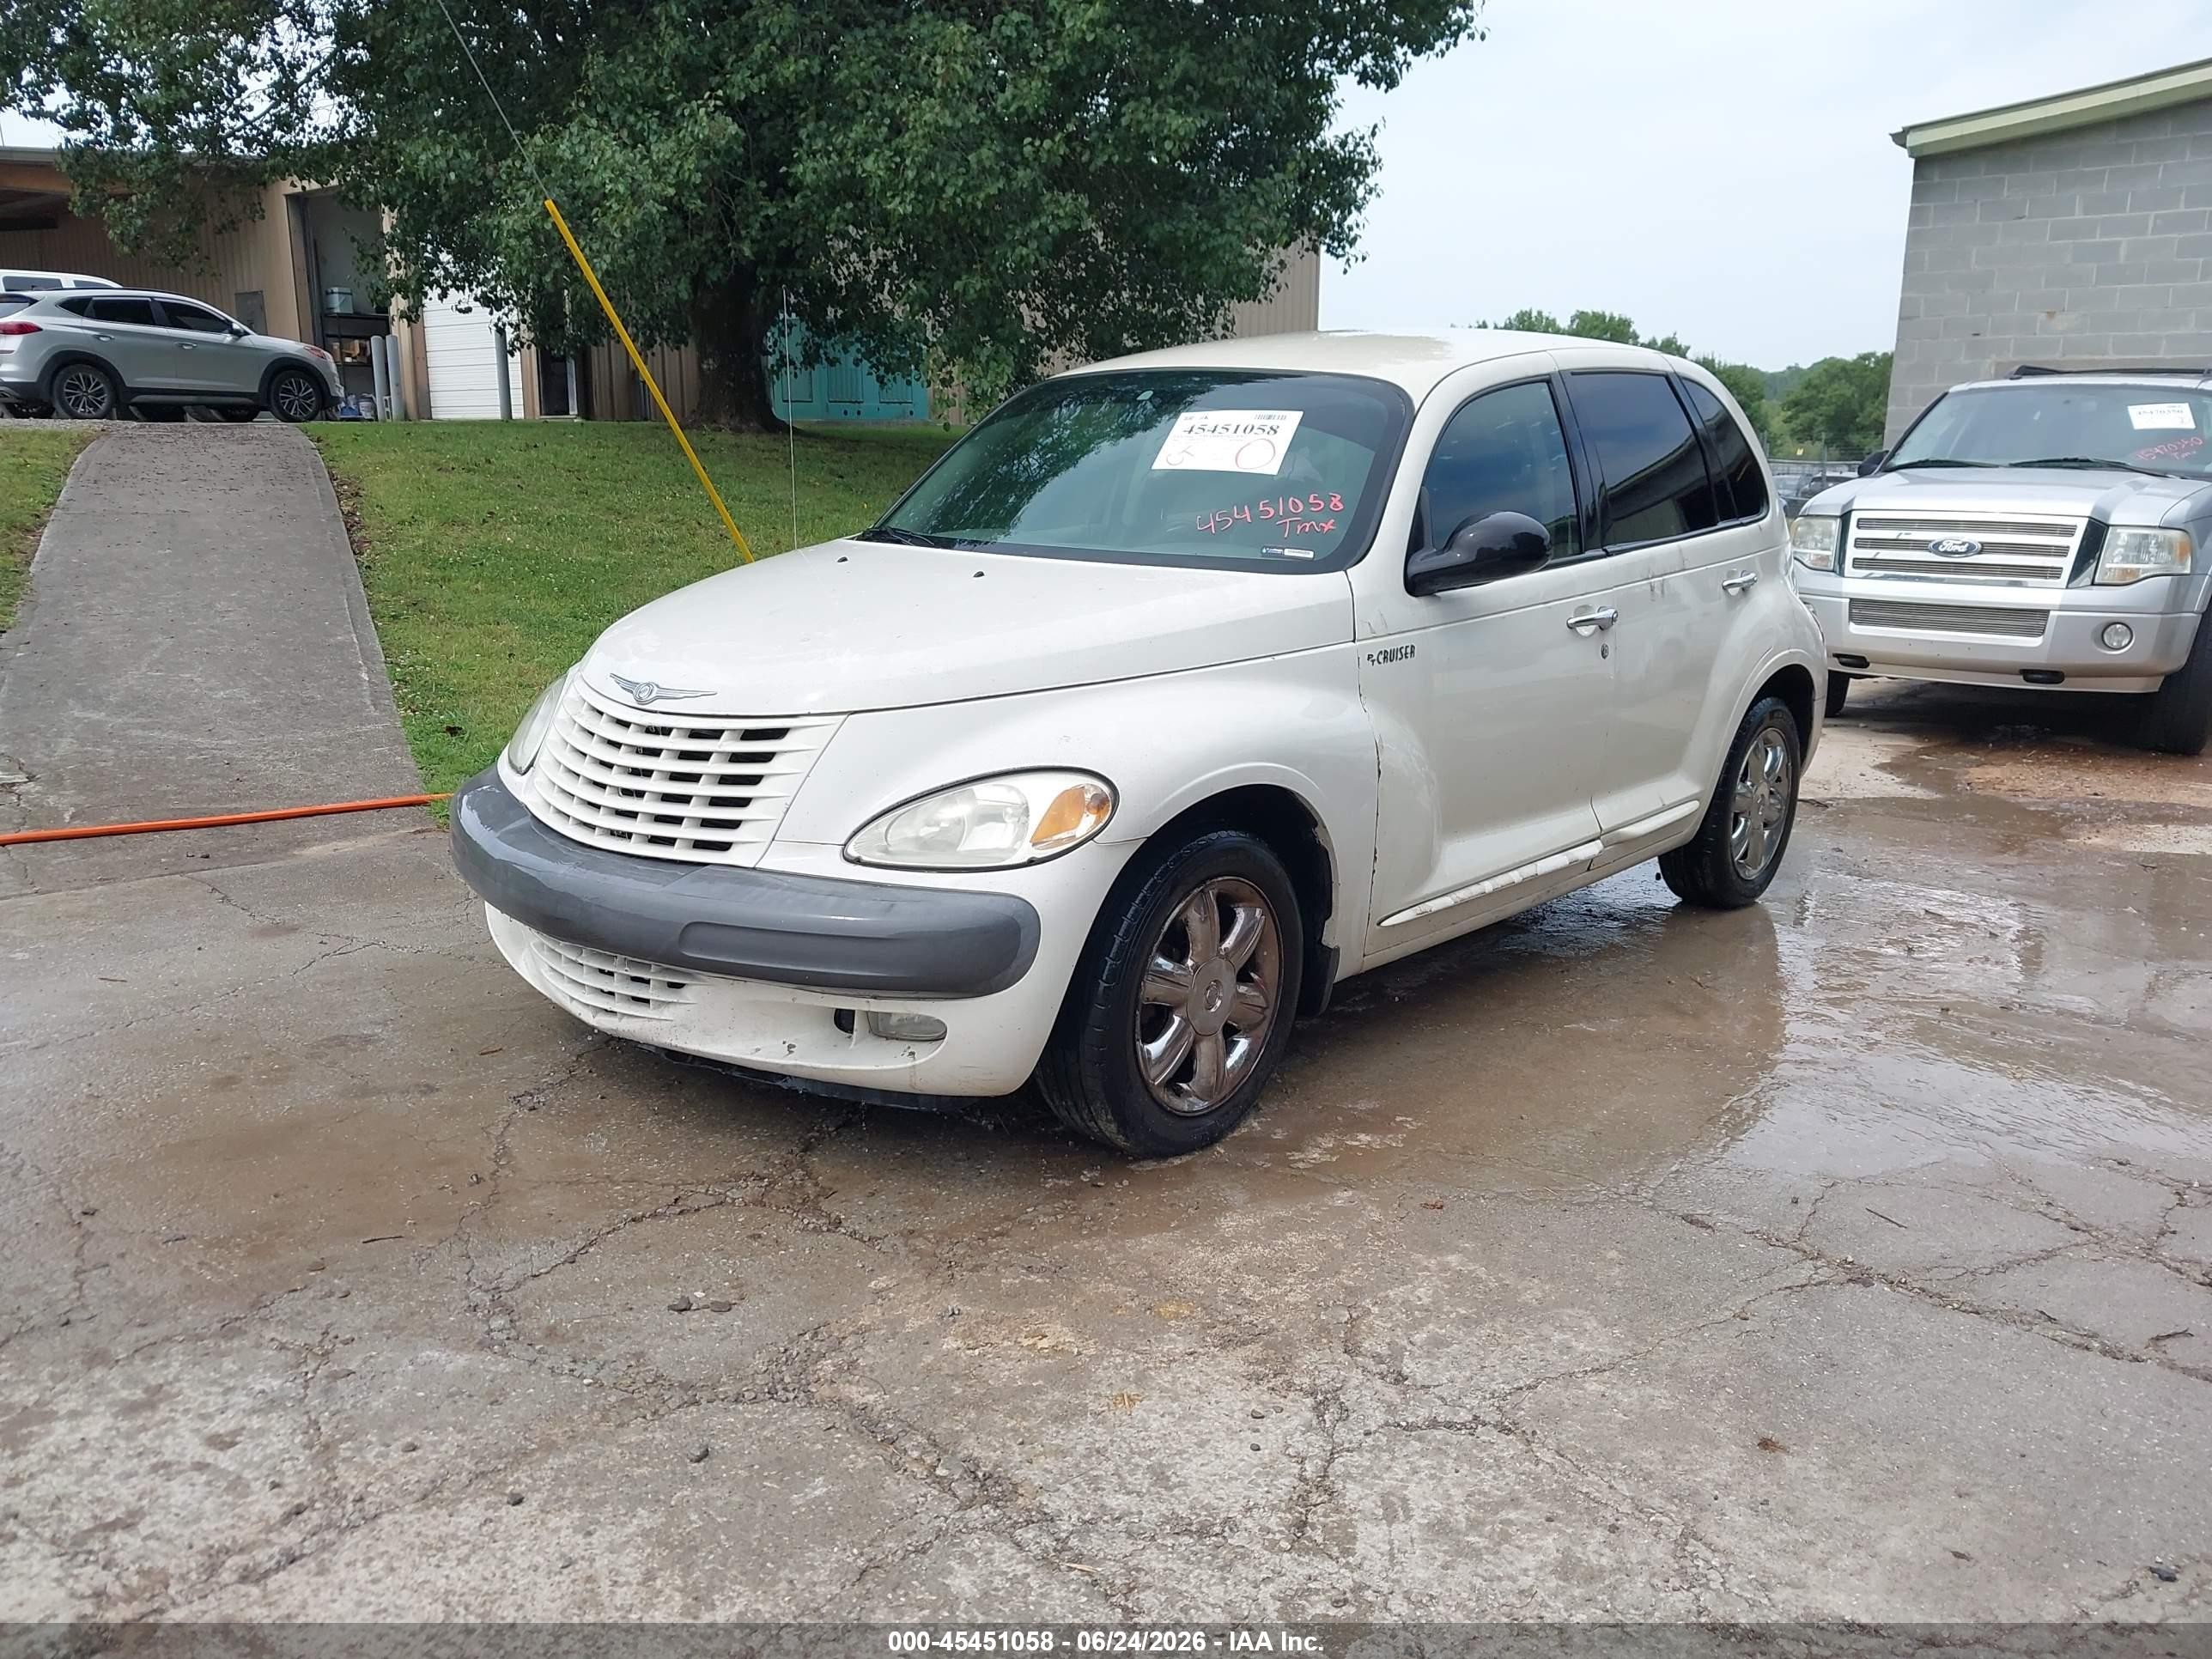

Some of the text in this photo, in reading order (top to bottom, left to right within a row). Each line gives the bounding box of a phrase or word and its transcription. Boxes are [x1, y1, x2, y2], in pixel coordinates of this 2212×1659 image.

[1182, 423, 1280, 436] 45451058
[1196, 492, 1345, 534] 45451058
[1938, 539, 1969, 552] Ford
[1376, 644, 1415, 665] CRUISER
